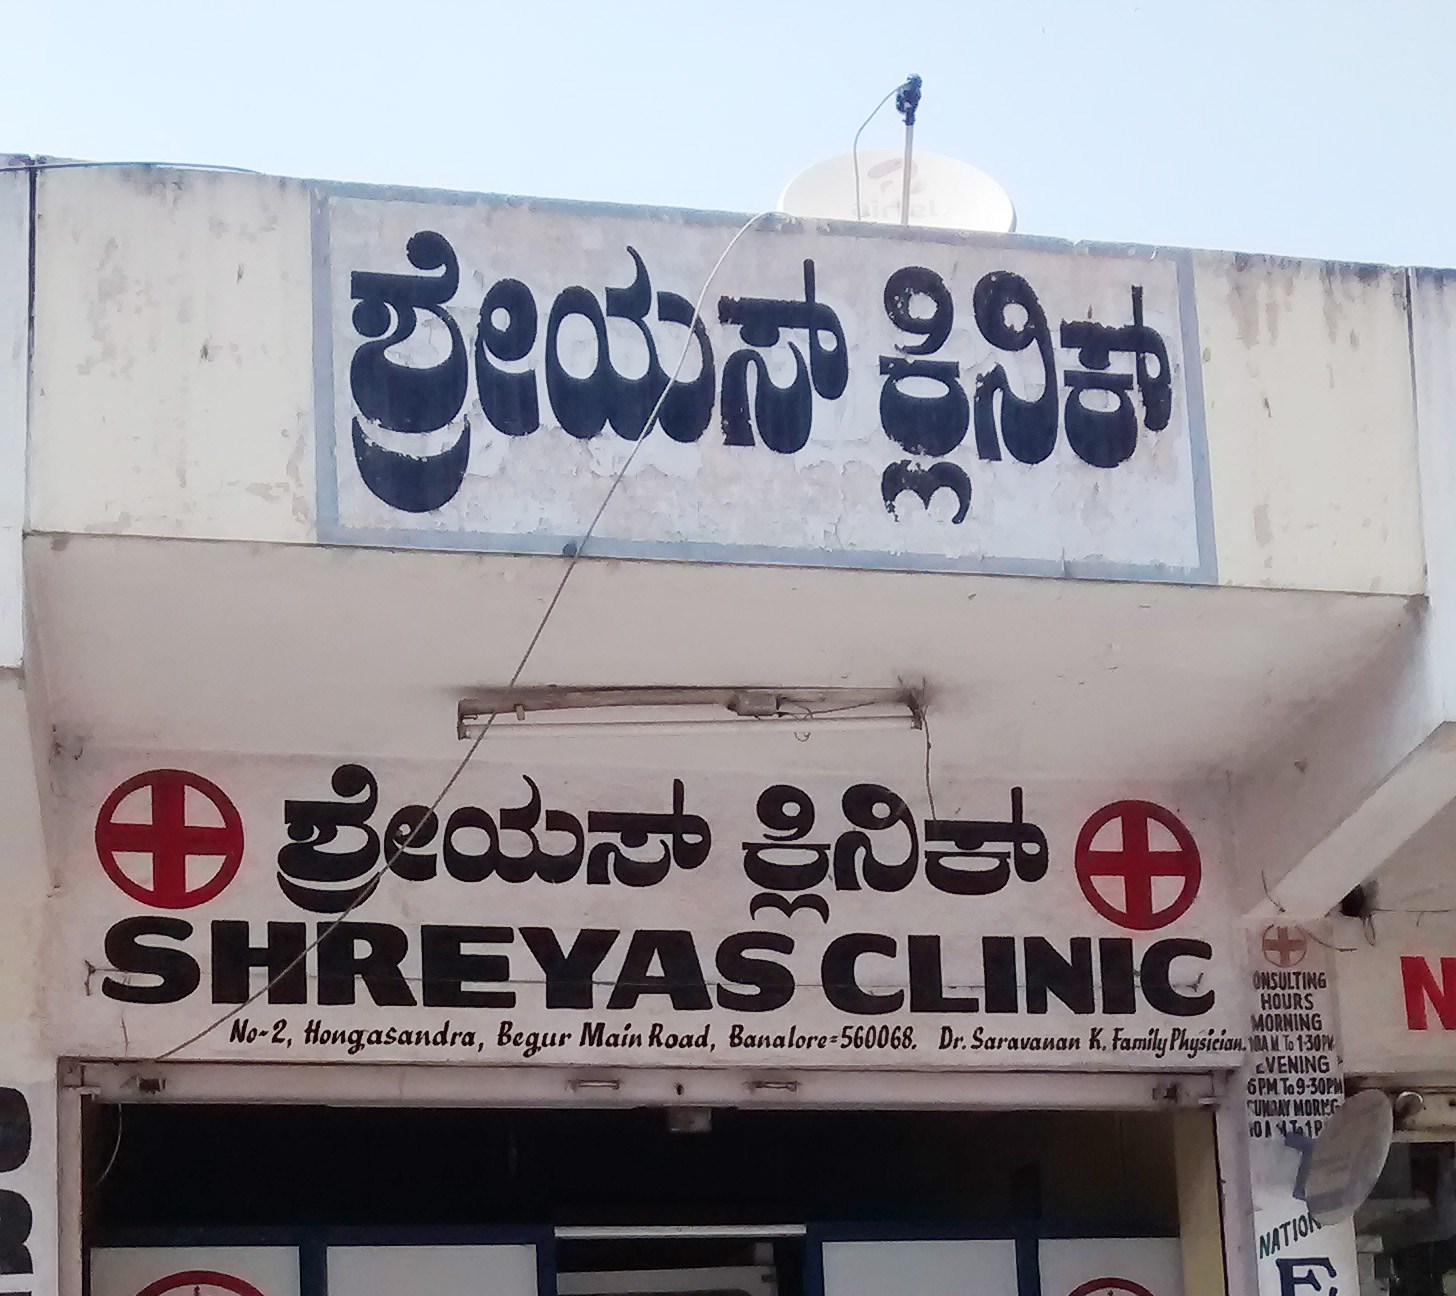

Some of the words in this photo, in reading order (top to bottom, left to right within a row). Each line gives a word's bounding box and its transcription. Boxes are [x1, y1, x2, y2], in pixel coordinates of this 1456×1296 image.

[350, 231, 848, 512] ಶ್ರೇಯಸ್
[880, 266, 1173, 524] ಕ್ಲಿನಿಕ್
[277, 763, 711, 913] ಶ್ರೇಯಸ್
[742, 783, 1048, 923] ಕ್ಲಿನಿಕ್
[102, 916, 795, 1013] SHREYAS
[821, 932, 1215, 1017] CLINIC
[1252, 970, 1327, 990] ONSULTING
[1250, 1013, 1323, 1032] MORNING
[1260, 993, 1314, 1011] HOURS
[304, 1019, 484, 1054] Hongasandra,
[497, 1020, 572, 1057] Begur
[579, 1022, 642, 1047] Main
[648, 1023, 716, 1052] Road,
[938, 1026, 967, 1050] Dr.
[970, 1026, 1081, 1051] Saravanan
[1088, 1027, 1107, 1051] K.
[1112, 1027, 1167, 1059] Family
[1170, 1027, 1247, 1059] Physician.
[1259, 1211, 1322, 1259] NATION
